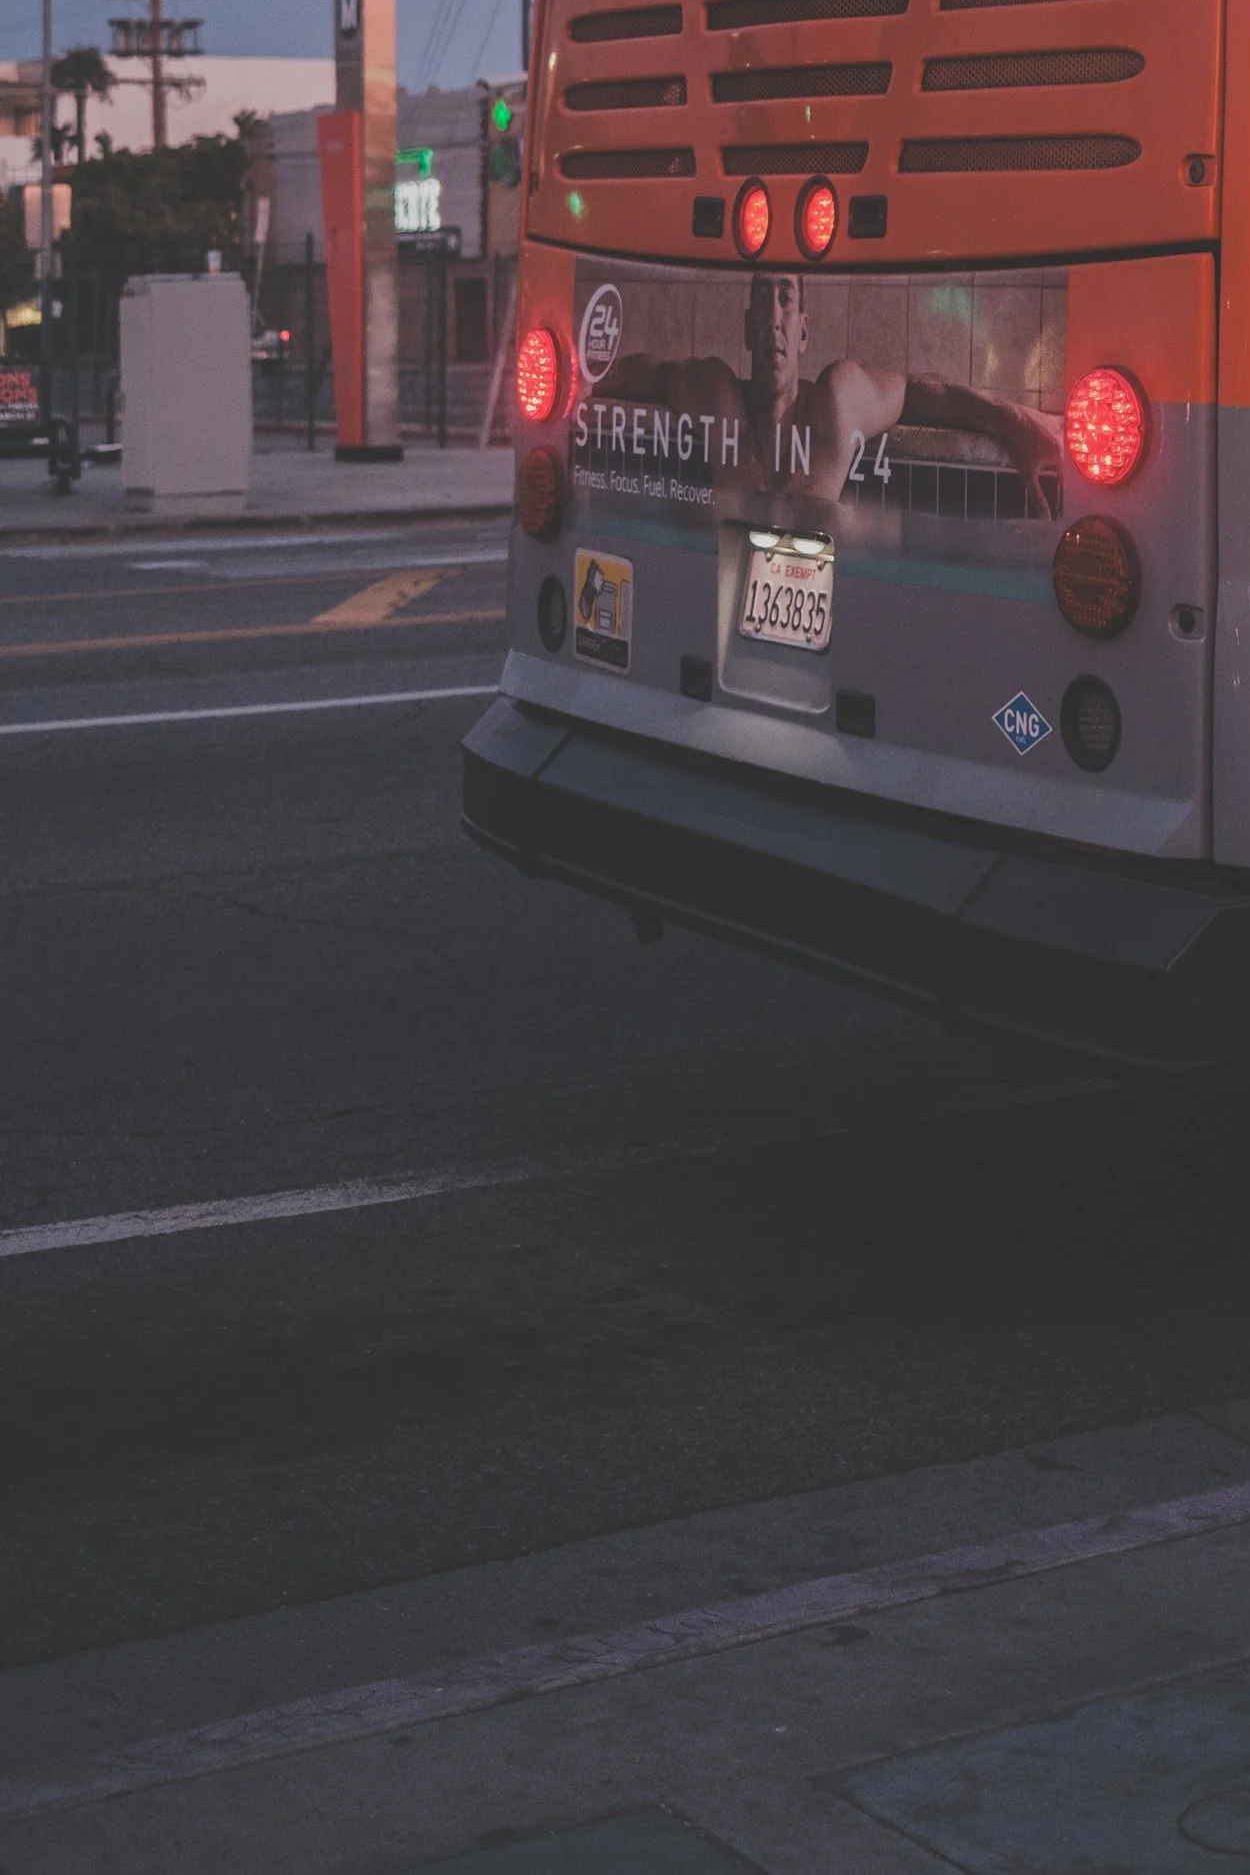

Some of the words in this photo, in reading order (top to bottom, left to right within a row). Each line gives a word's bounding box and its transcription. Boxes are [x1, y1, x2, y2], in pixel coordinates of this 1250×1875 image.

[589, 304, 620, 350] 24
[575, 403, 740, 467] STRENGTH
[774, 423, 811, 475] IN
[849, 429, 892, 484] 24
[573, 465, 608, 490] Fitness.
[611, 470, 641, 494] Focus.
[643, 475, 667, 498] Fuel.
[670, 478, 716, 505] Recover.
[770, 562, 782, 574] CA
[785, 565, 817, 581] EXEMPT
[746, 579, 828, 636] 1363835
[1004, 708, 1040, 738] CNG
